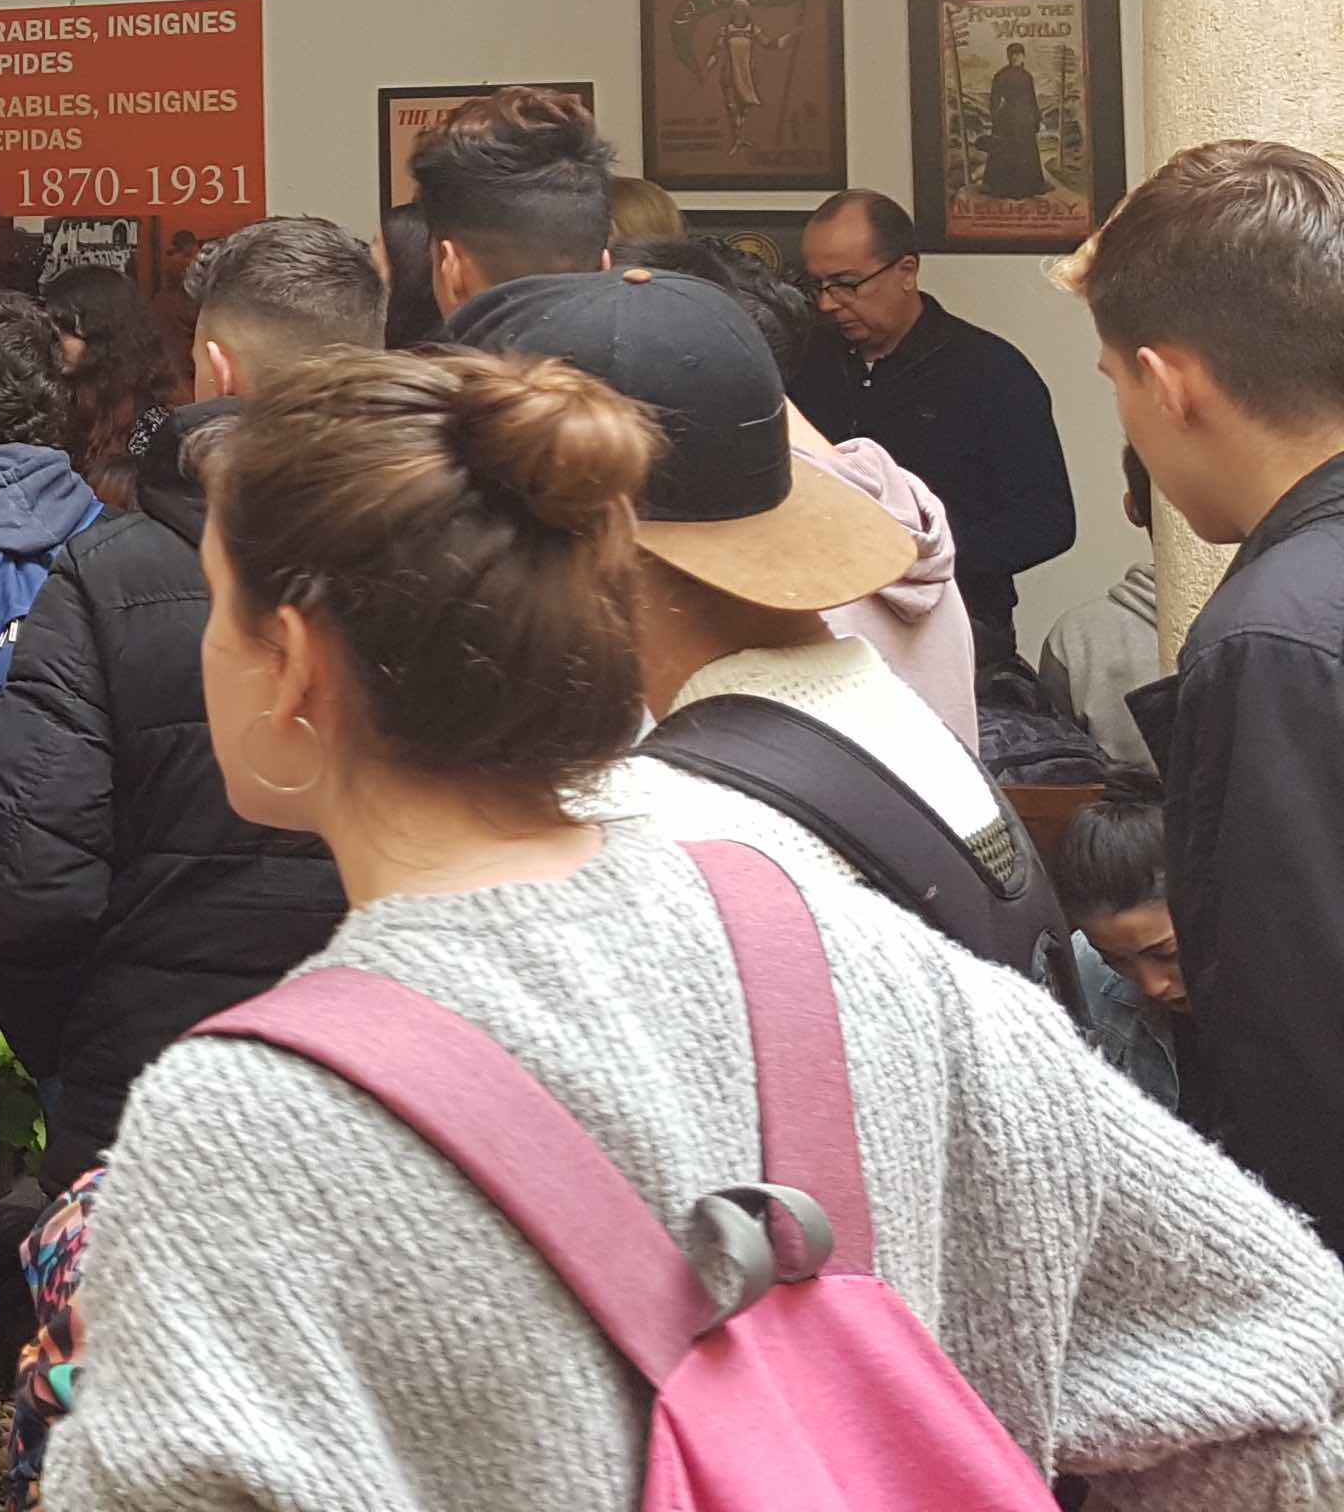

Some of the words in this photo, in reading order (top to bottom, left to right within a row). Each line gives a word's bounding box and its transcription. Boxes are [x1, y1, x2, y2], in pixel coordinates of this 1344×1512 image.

[108, 10, 237, 37] INSIGNES
[992, 17, 1072, 39] WORLD
[108, 89, 238, 115] INSIGNES
[17, 164, 252, 208] 1870-1931
